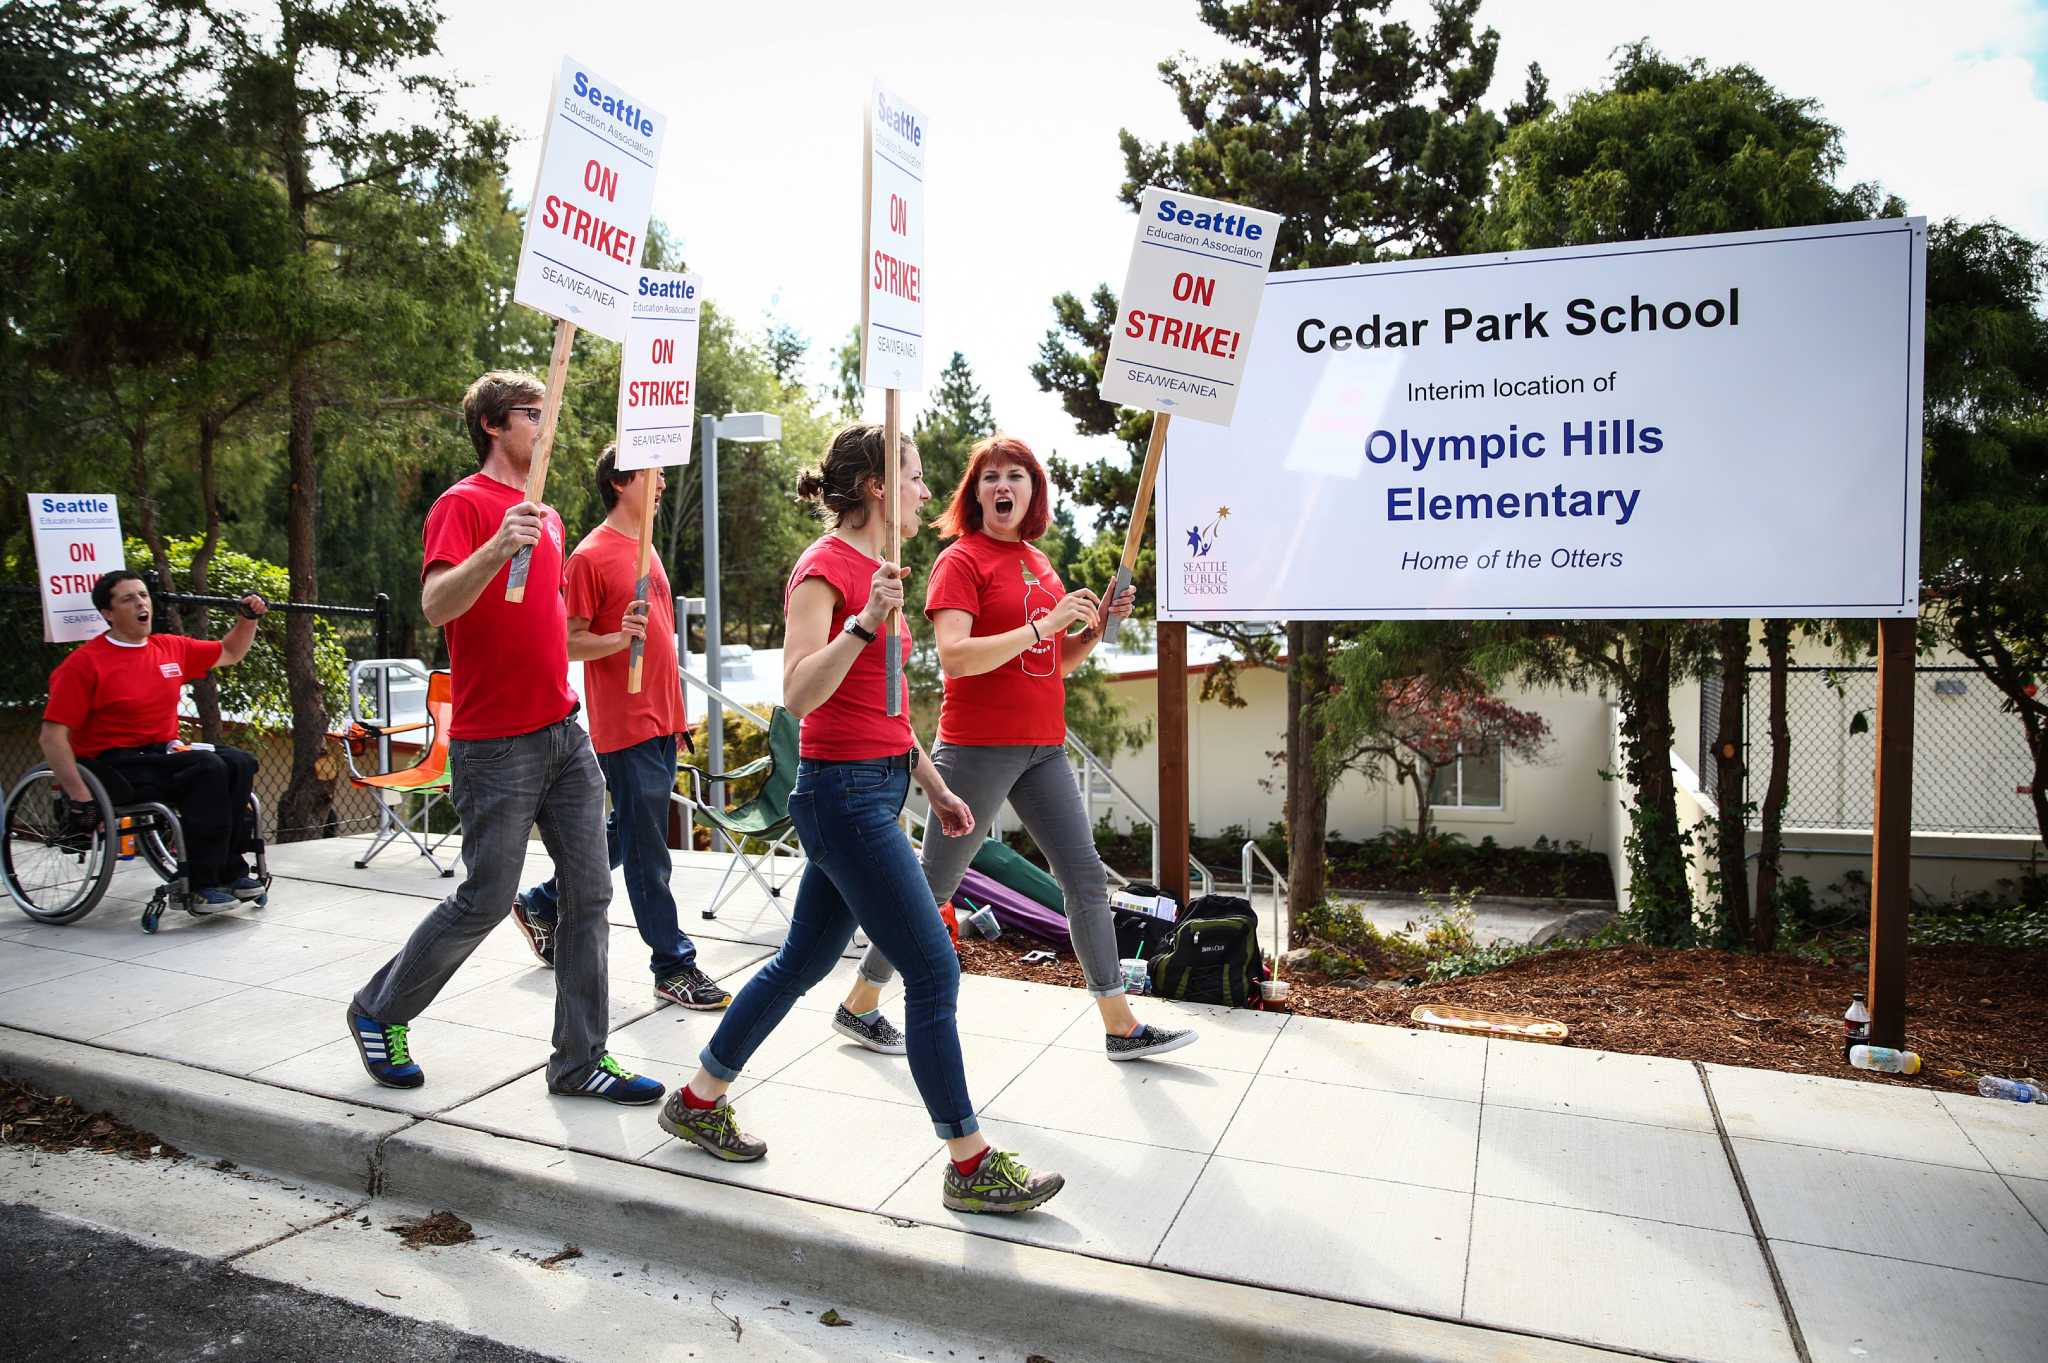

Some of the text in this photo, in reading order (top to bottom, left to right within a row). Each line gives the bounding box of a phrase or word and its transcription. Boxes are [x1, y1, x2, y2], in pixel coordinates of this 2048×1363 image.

[573, 72, 654, 137] Seattle
[878, 92, 921, 147] Seattle
[564, 97, 654, 159] Education Association
[584, 159, 618, 202] ON
[543, 195, 636, 265] STRIKE!
[890, 193, 907, 237] ON
[1157, 200, 1263, 240] Seattle
[1146, 225, 1263, 259] Education Association
[542, 266, 615, 309] SEA/WEA/NEA
[638, 276, 695, 299] Seattle
[874, 249, 920, 303] STRIKE!
[1172, 272, 1216, 306] ON
[1125, 310, 1240, 360] STRIKE!
[1296, 288, 1739, 353] Cedar Park School
[652, 338, 674, 365] ON
[628, 381, 689, 407] STRIKE!
[1127, 370, 1217, 399] SEA/WEA/NEA
[1408, 371, 1618, 402] Interim location of
[1365, 419, 1664, 471] Olympic Hills
[42, 498, 108, 513] Seattle
[1387, 483, 1641, 525] Elementary
[69, 543, 96, 562] ON
[1183, 561, 1228, 572] SEATTLE
[1401, 548, 1624, 571] Home of the Otters
[1183, 573, 1228, 584] PUBLIC
[1183, 585, 1228, 595] SCHOOLS
